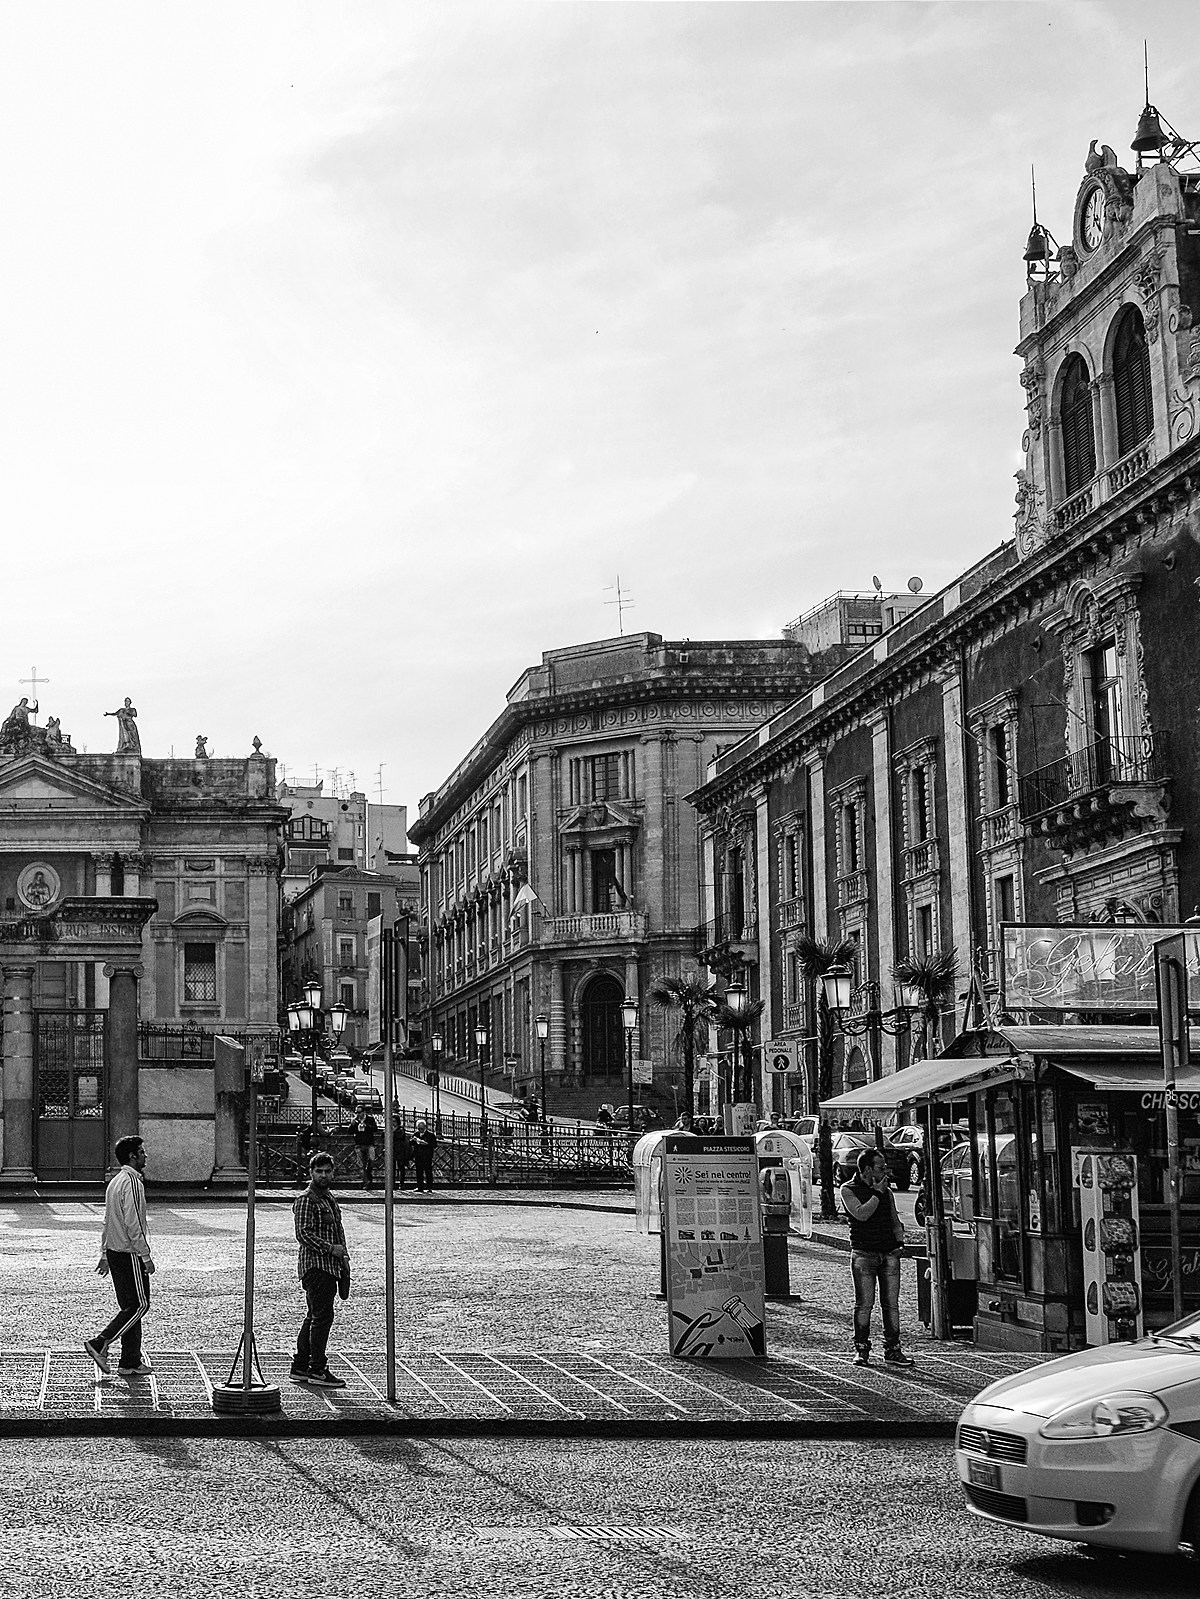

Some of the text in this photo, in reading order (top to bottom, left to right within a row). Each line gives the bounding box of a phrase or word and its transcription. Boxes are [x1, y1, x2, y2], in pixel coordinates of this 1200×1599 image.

[1141, 1092, 1200, 1109] CHISC
[695, 1170, 751, 1179] Sei nel centro!
